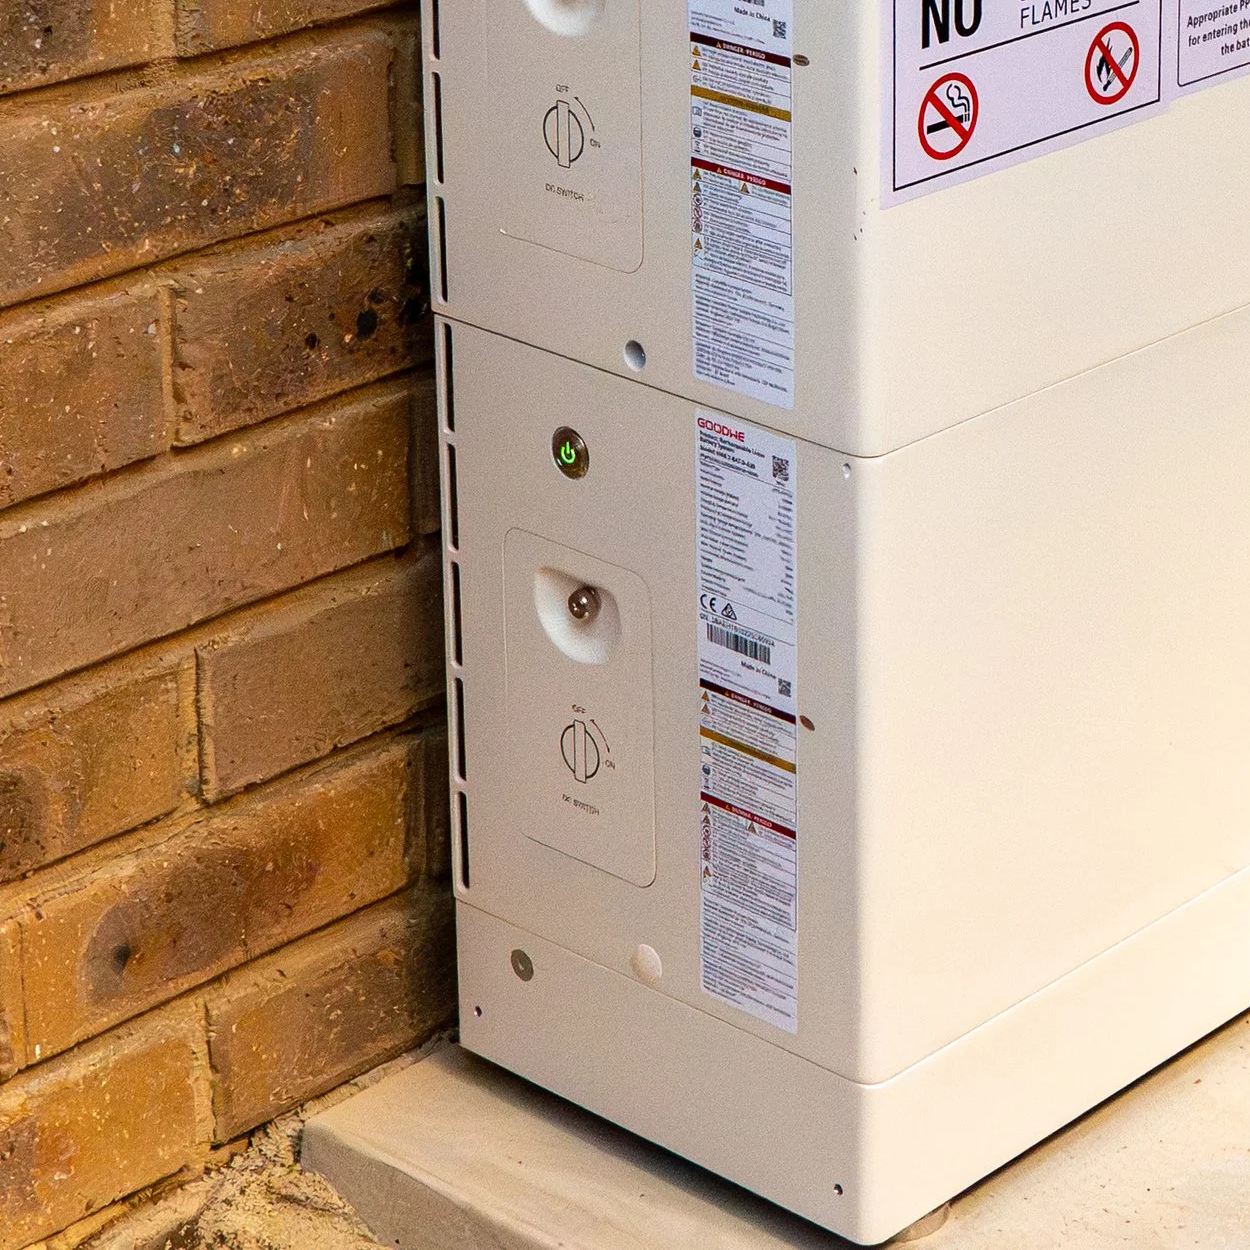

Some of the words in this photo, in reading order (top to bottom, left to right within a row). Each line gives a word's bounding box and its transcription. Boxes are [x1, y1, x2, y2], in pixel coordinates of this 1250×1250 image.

[734, 7, 748, 16] Made
[756, 12, 770, 22] China
[1186, 4, 1238, 28] Appropriate
[1188, 35, 1200, 47] for
[1202, 22, 1238, 42] entering
[1221, 44, 1234, 56] the
[556, 186, 584, 201] SWITCH
[698, 418, 744, 442] GOODWE
[741, 661, 755, 670] Made
[604, 760, 616, 770] ON
